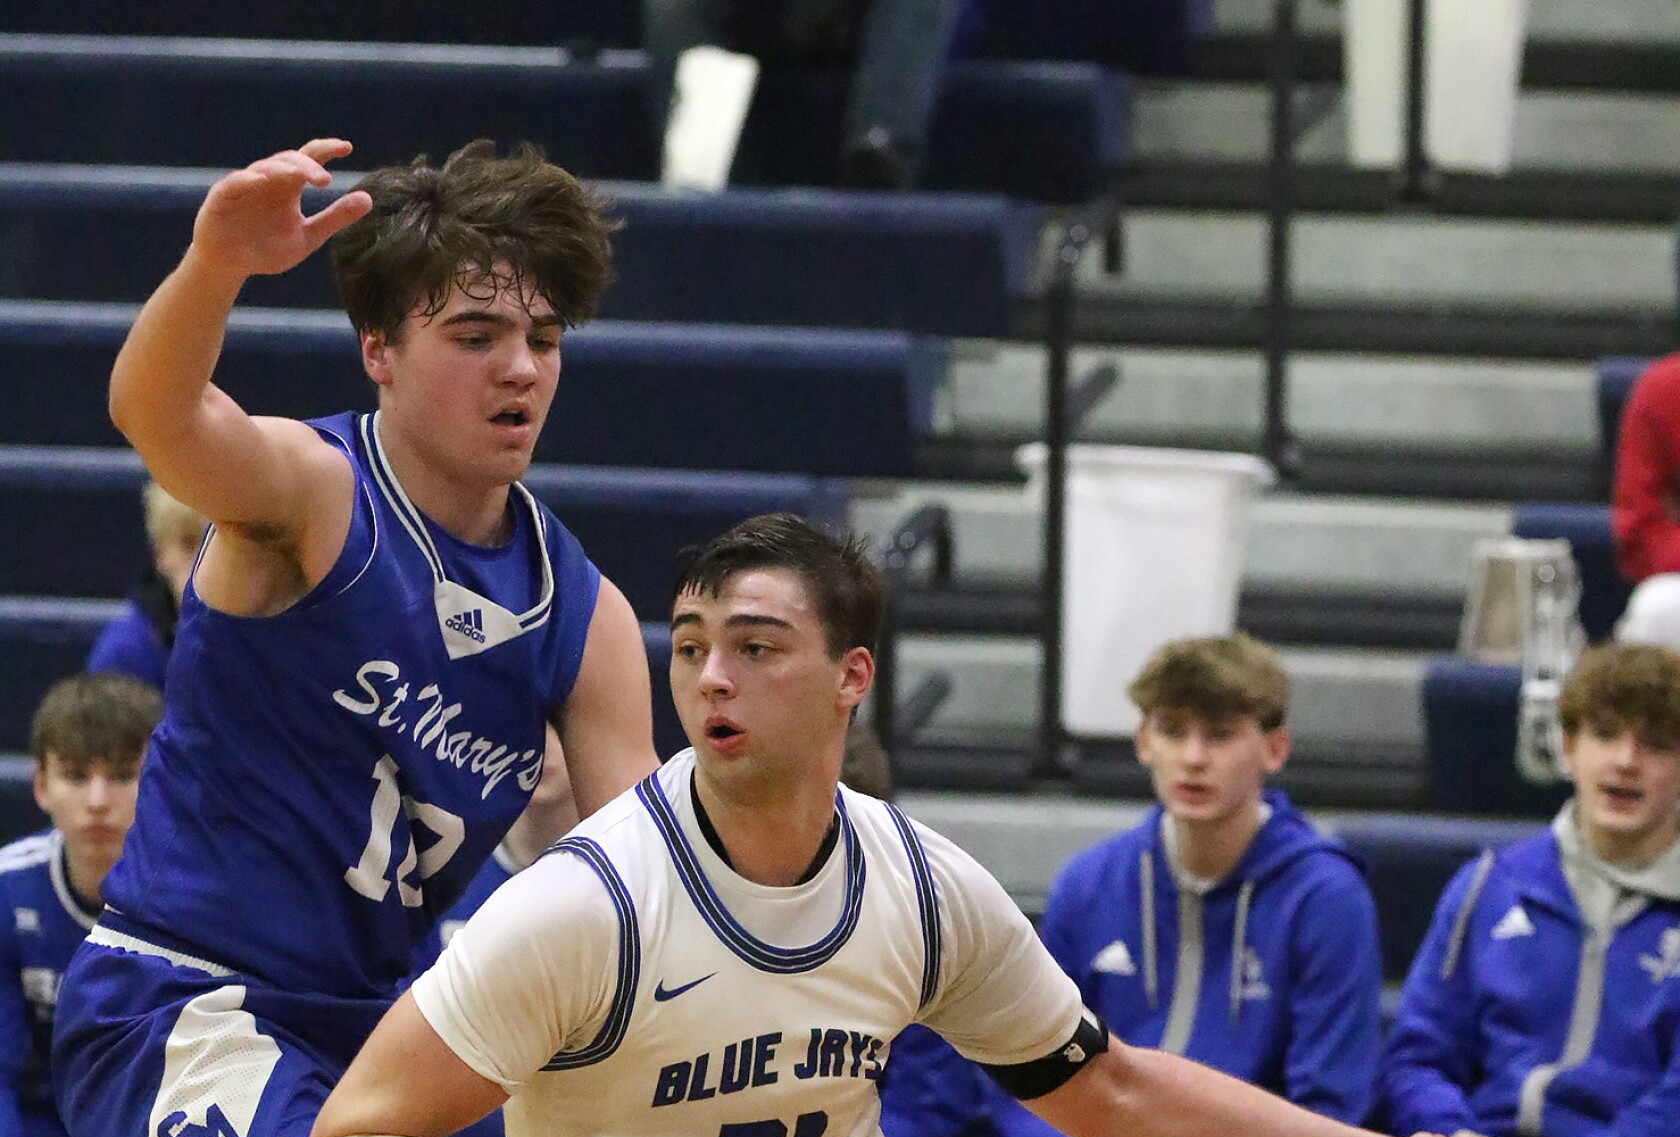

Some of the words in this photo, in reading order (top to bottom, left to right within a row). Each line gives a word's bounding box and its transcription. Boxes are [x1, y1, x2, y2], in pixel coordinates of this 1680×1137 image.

[445, 618, 486, 644] adidas
[651, 1031, 783, 1108] BLUE
[794, 1028, 884, 1081] JAYS
